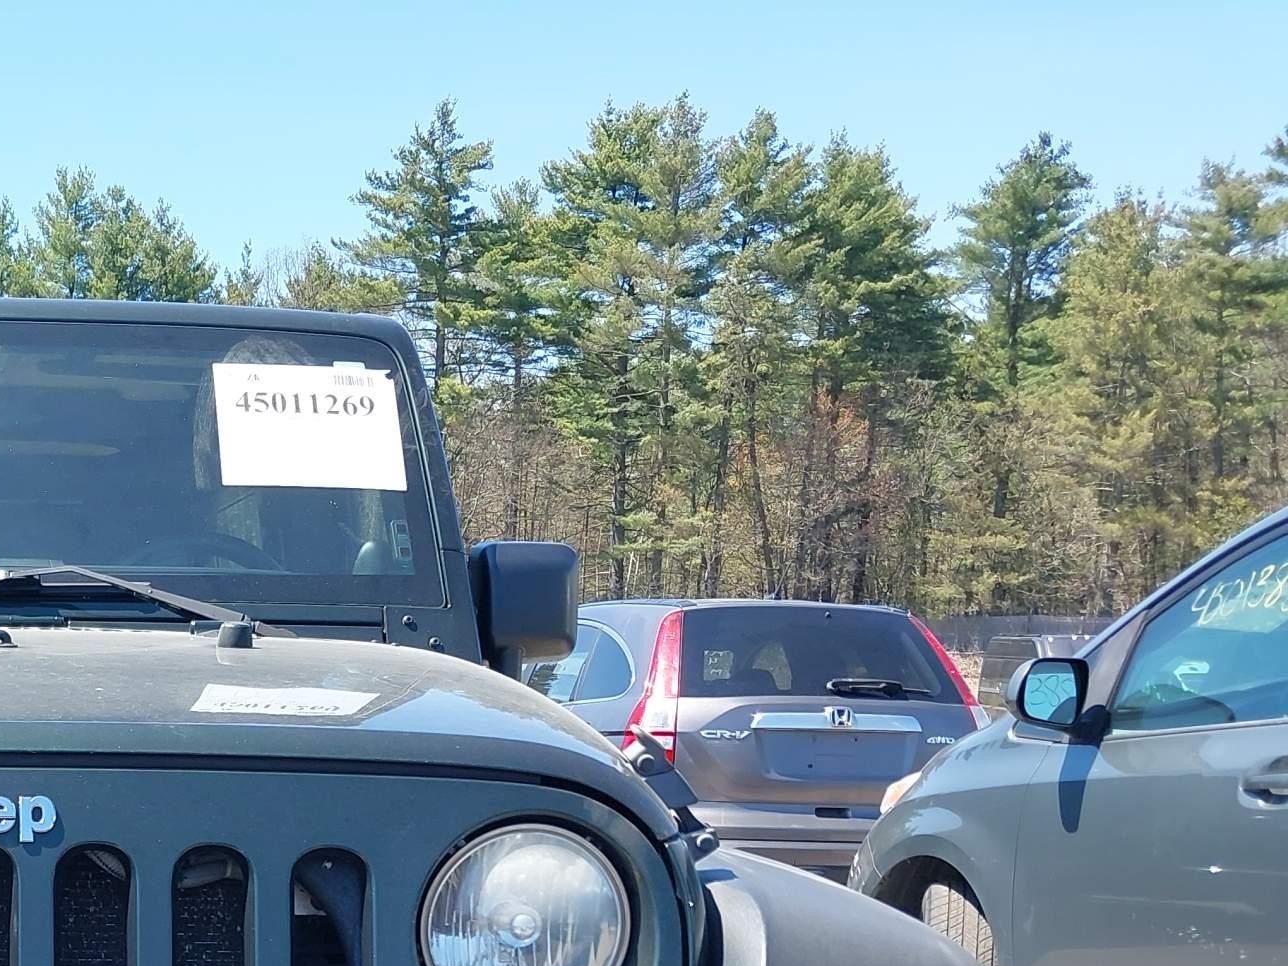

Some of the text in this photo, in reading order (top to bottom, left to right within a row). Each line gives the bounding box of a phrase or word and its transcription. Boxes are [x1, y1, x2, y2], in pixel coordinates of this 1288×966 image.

[235, 391, 375, 416] 45011269
[1191, 562, 1288, 626] 450138
[699, 730, 752, 739] CR-V
